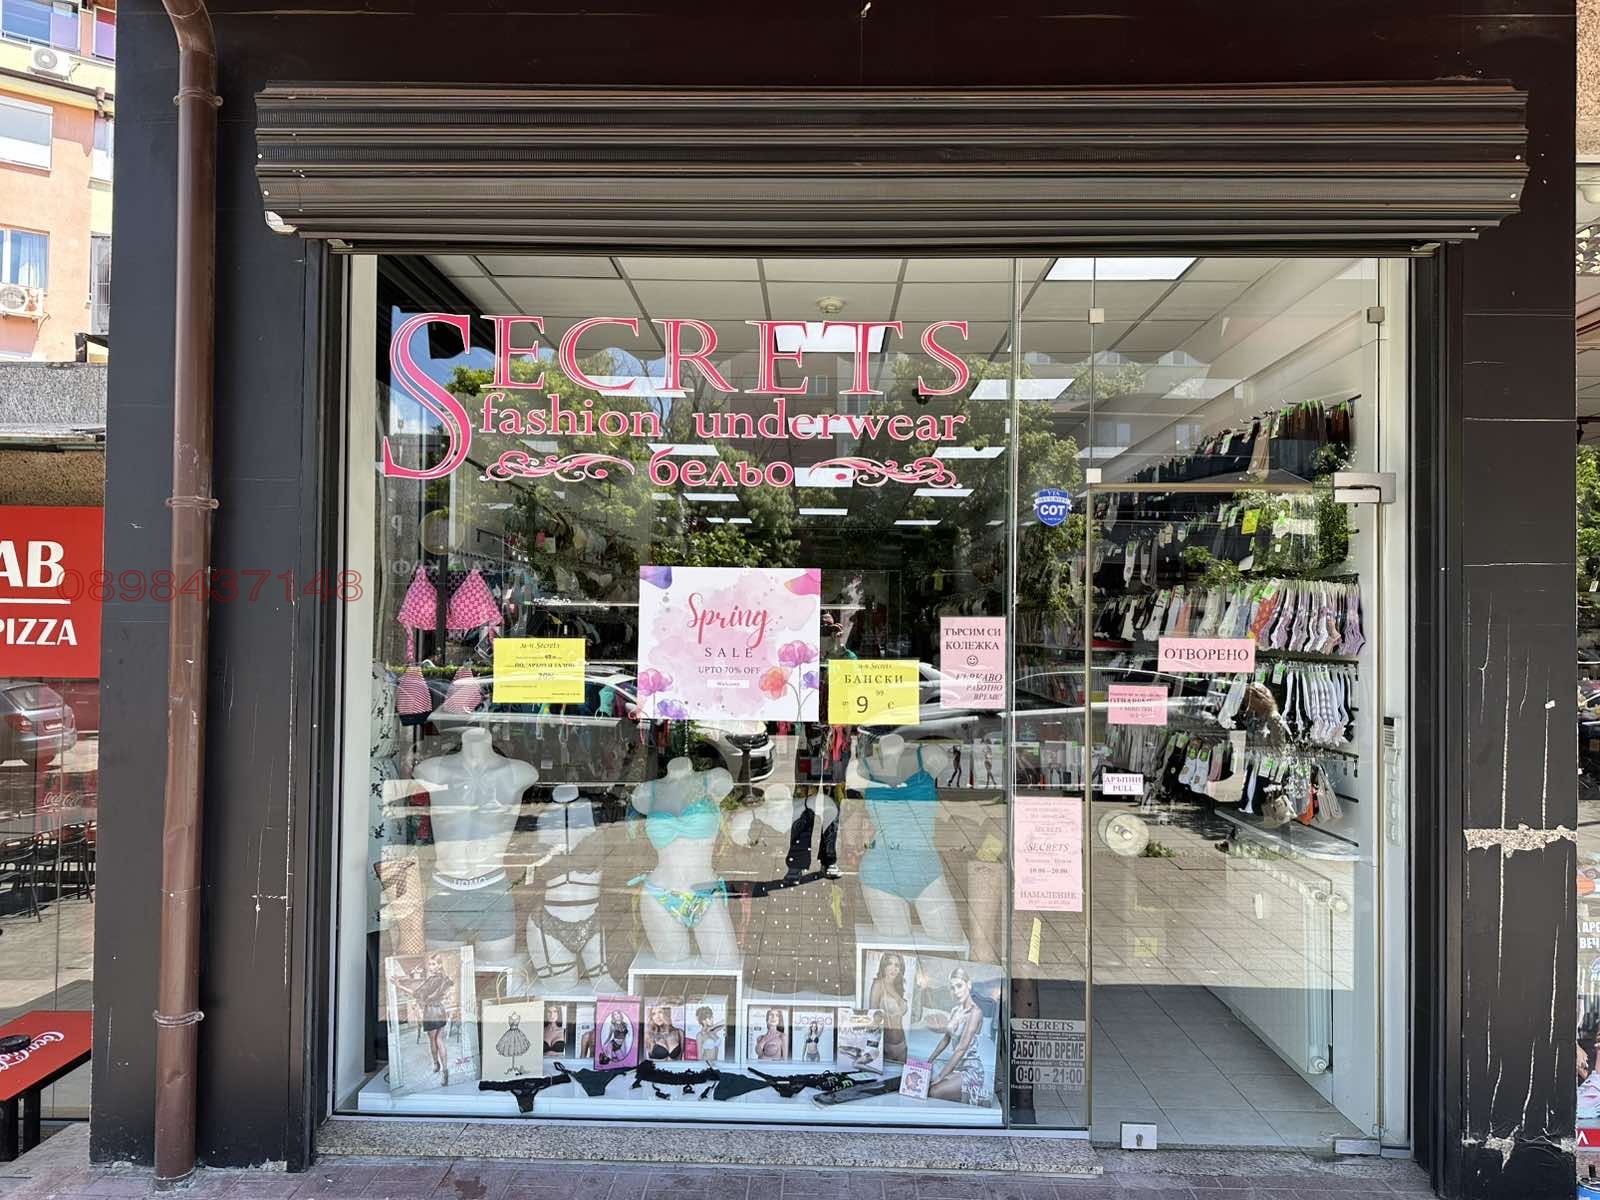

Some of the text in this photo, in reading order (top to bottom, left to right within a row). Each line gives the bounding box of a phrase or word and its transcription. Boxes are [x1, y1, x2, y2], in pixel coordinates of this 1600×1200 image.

[383, 312, 970, 480] SECRETS
[479, 394, 967, 441] fashion underwear
[648, 447, 794, 488] бельо
[687, 592, 773, 649] Spring
[944, 627, 1001, 637] ТЪРСИМ СИ
[704, 647, 753, 658] SALE
[945, 641, 1000, 650] КОЛЕЖКА
[1164, 647, 1249, 661] ОТВОРЕНО
[698, 666, 761, 674] UPTO 70% OFF
[844, 674, 903, 684] БАНСКИ
[856, 695, 868, 713] 9
[1027, 842, 1070, 853] SECRETS
[1022, 1020, 1074, 1030] SECRETS
[1011, 1040, 1084, 1060] РАБОТНО ВРЕМЕ
[1053, 1068, 1083, 1083] 21:00
